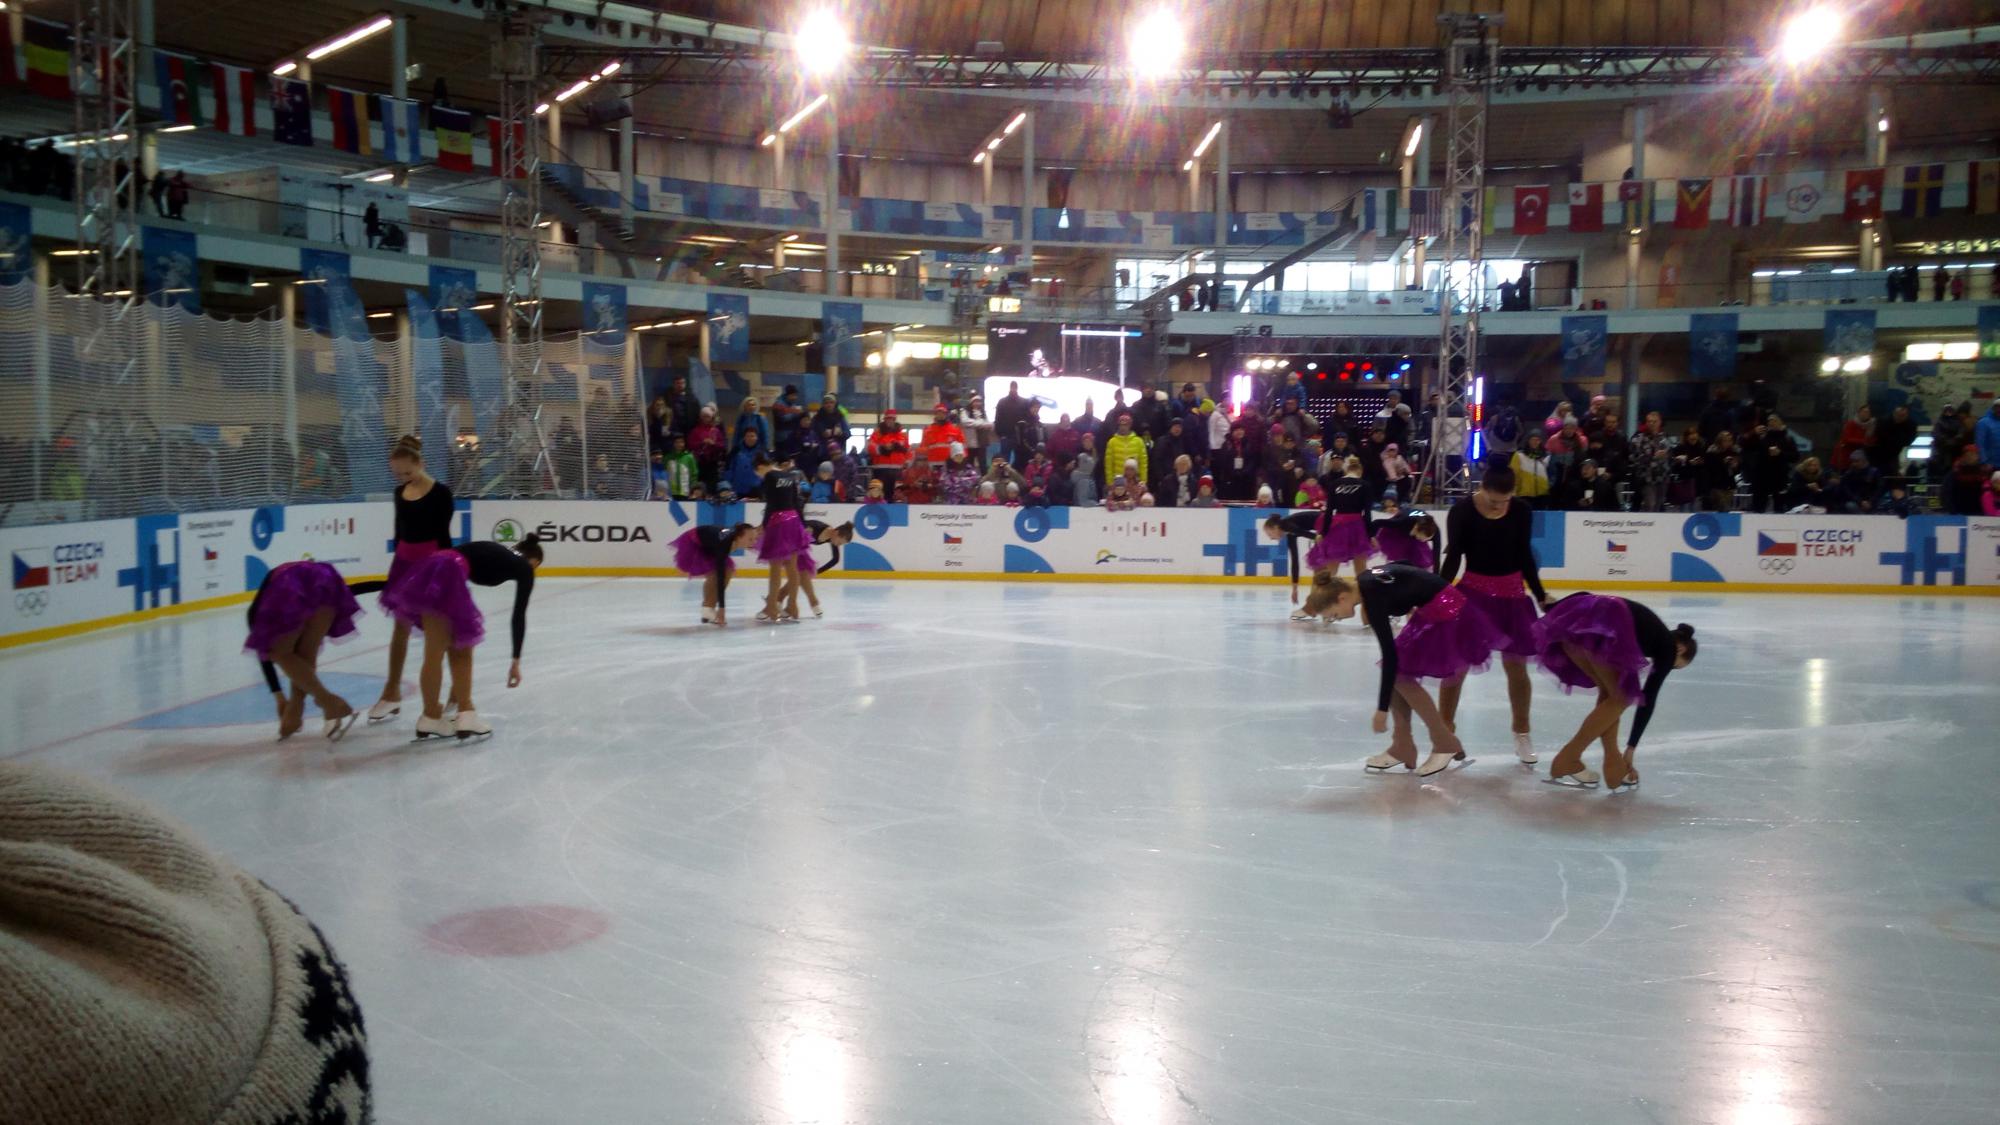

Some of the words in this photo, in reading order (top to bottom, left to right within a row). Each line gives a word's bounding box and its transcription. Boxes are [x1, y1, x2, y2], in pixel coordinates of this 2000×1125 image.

[537, 520, 652, 543] ŠKODA
[1802, 530, 1863, 543] CZECH
[53, 541, 105, 563] CZECH
[1803, 544, 1855, 557] TEAM
[54, 562, 99, 585] TEAM
